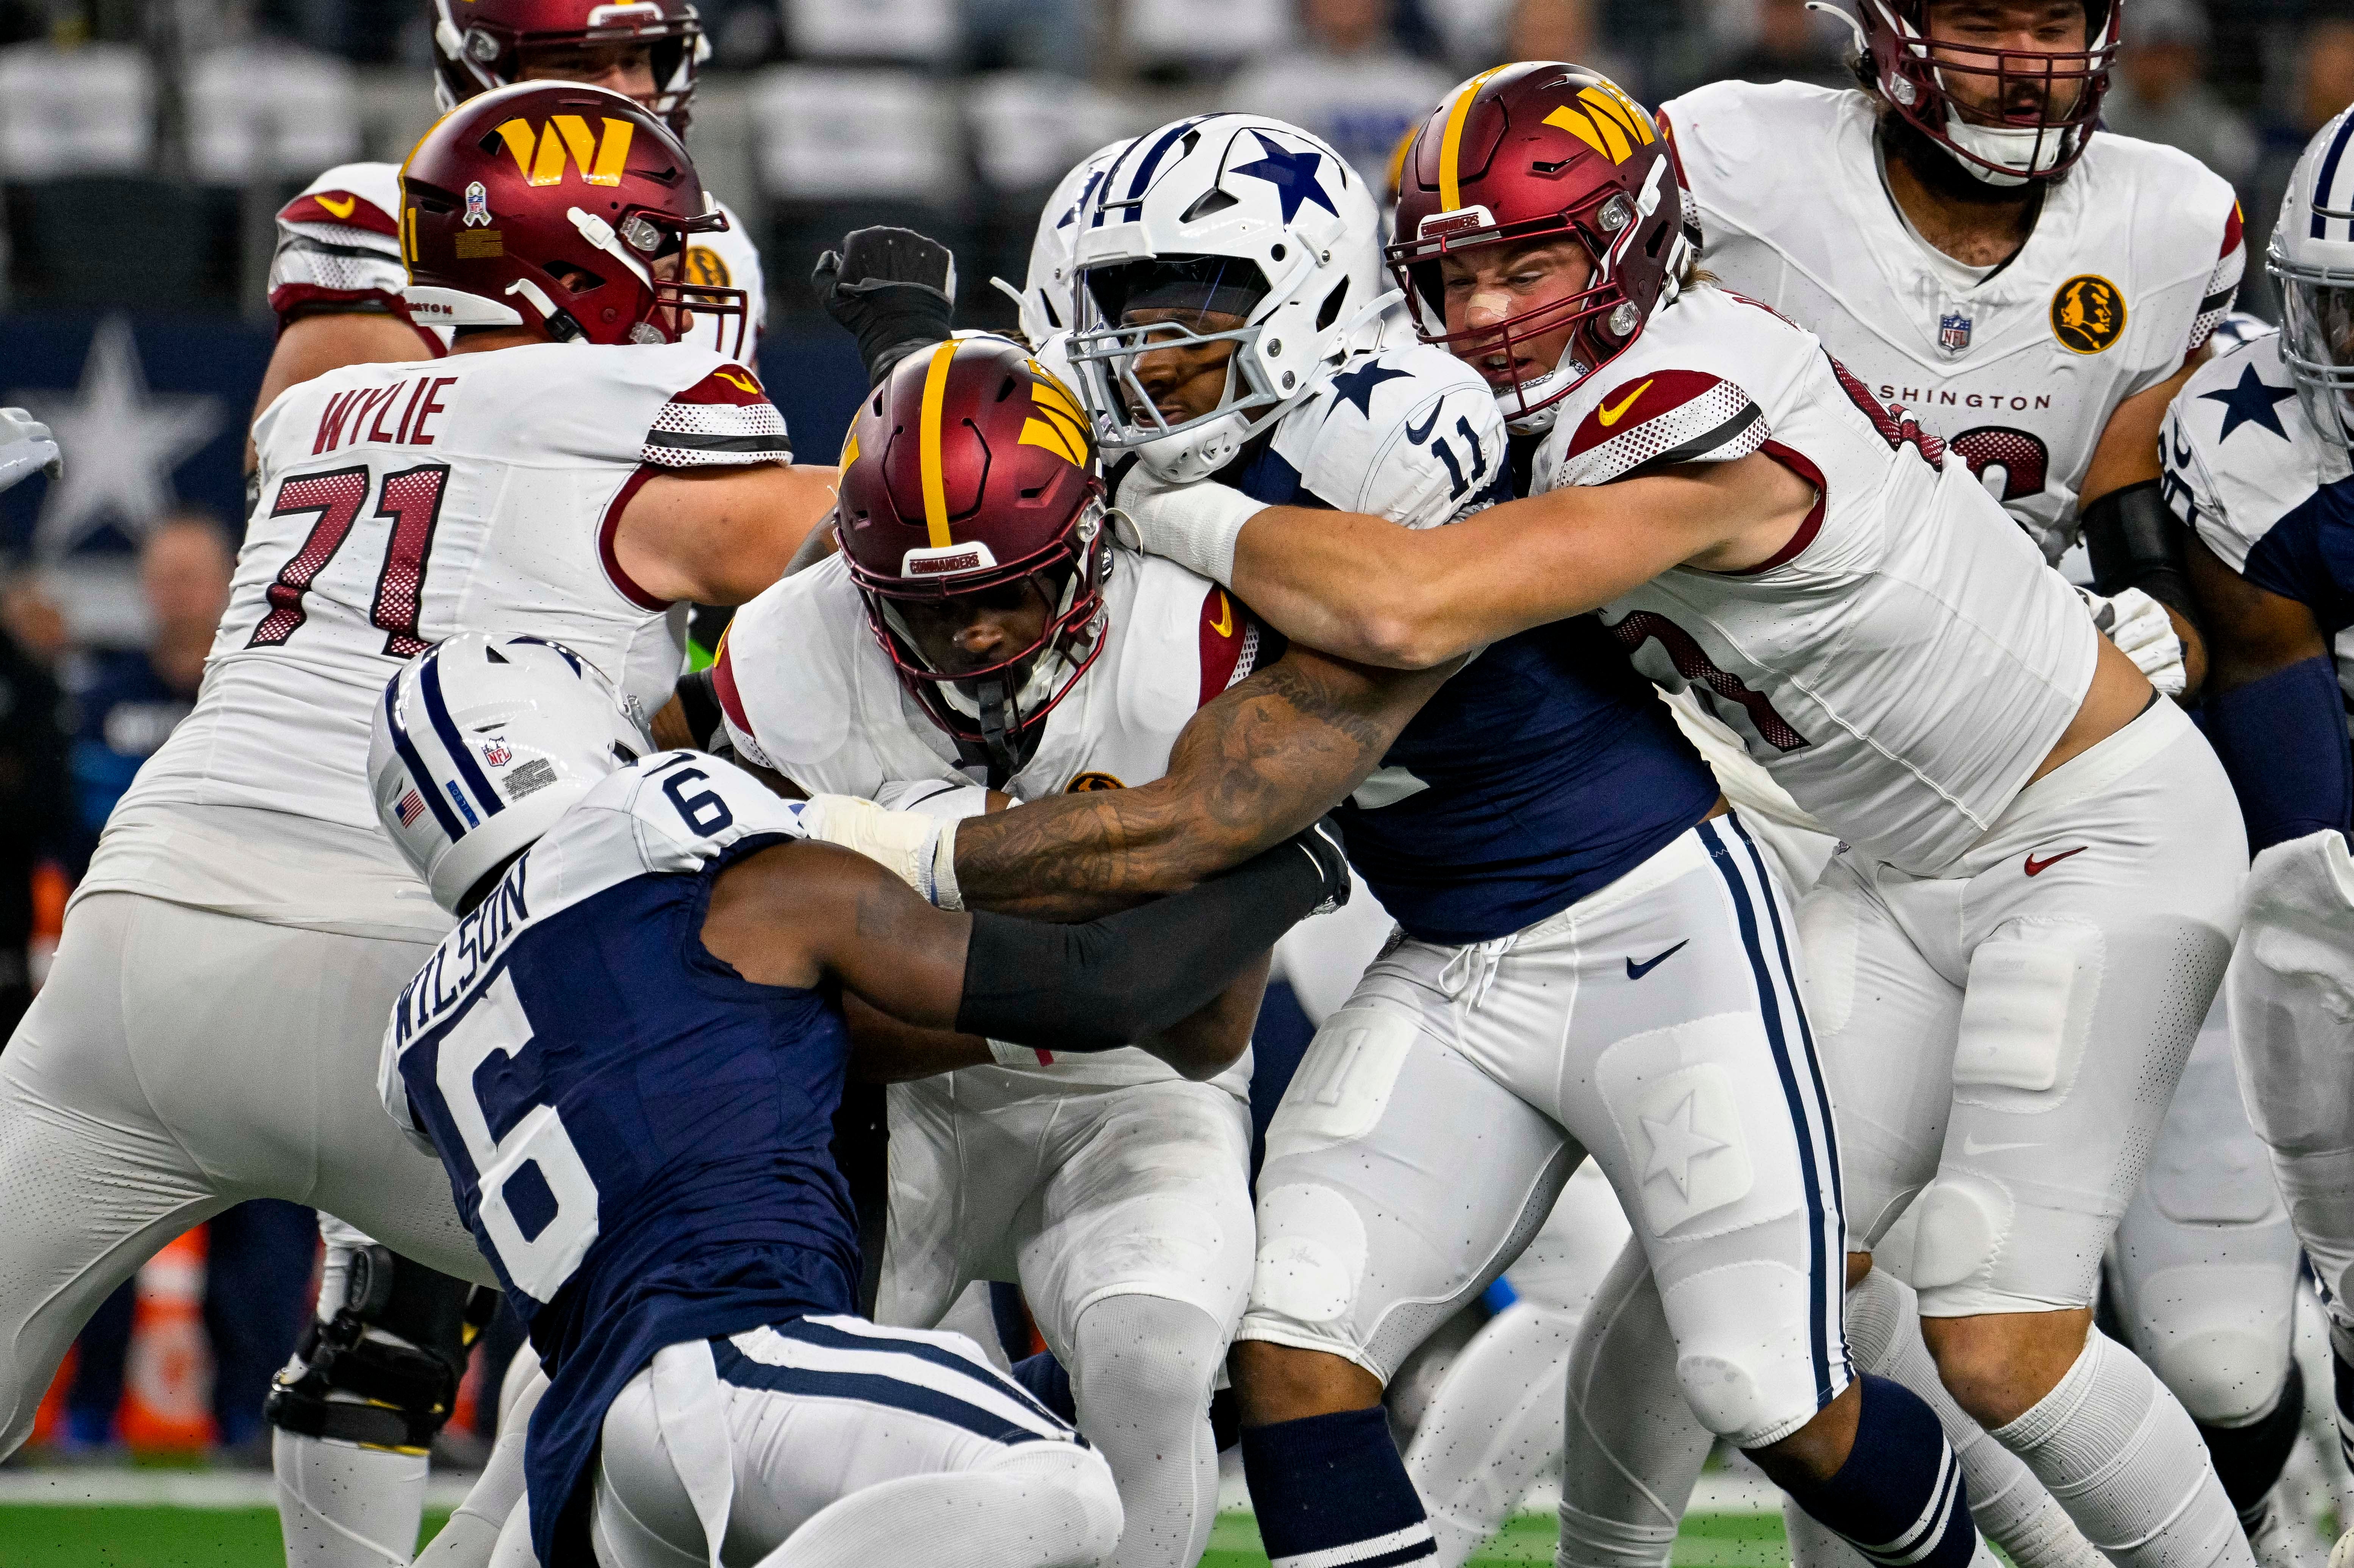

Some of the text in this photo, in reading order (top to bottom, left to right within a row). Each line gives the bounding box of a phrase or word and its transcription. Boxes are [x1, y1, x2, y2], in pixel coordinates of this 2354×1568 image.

[311, 377, 458, 456] WYLIE
[1877, 384, 2051, 411] SHINGTON
[1431, 415, 1486, 503] 11
[243, 464, 451, 657] 71
[910, 554, 979, 574] COMMANDERS
[487, 748, 510, 764] NFL
[662, 767, 733, 838] 6
[396, 850, 530, 1049] WILSON
[436, 966, 599, 1304] 6
